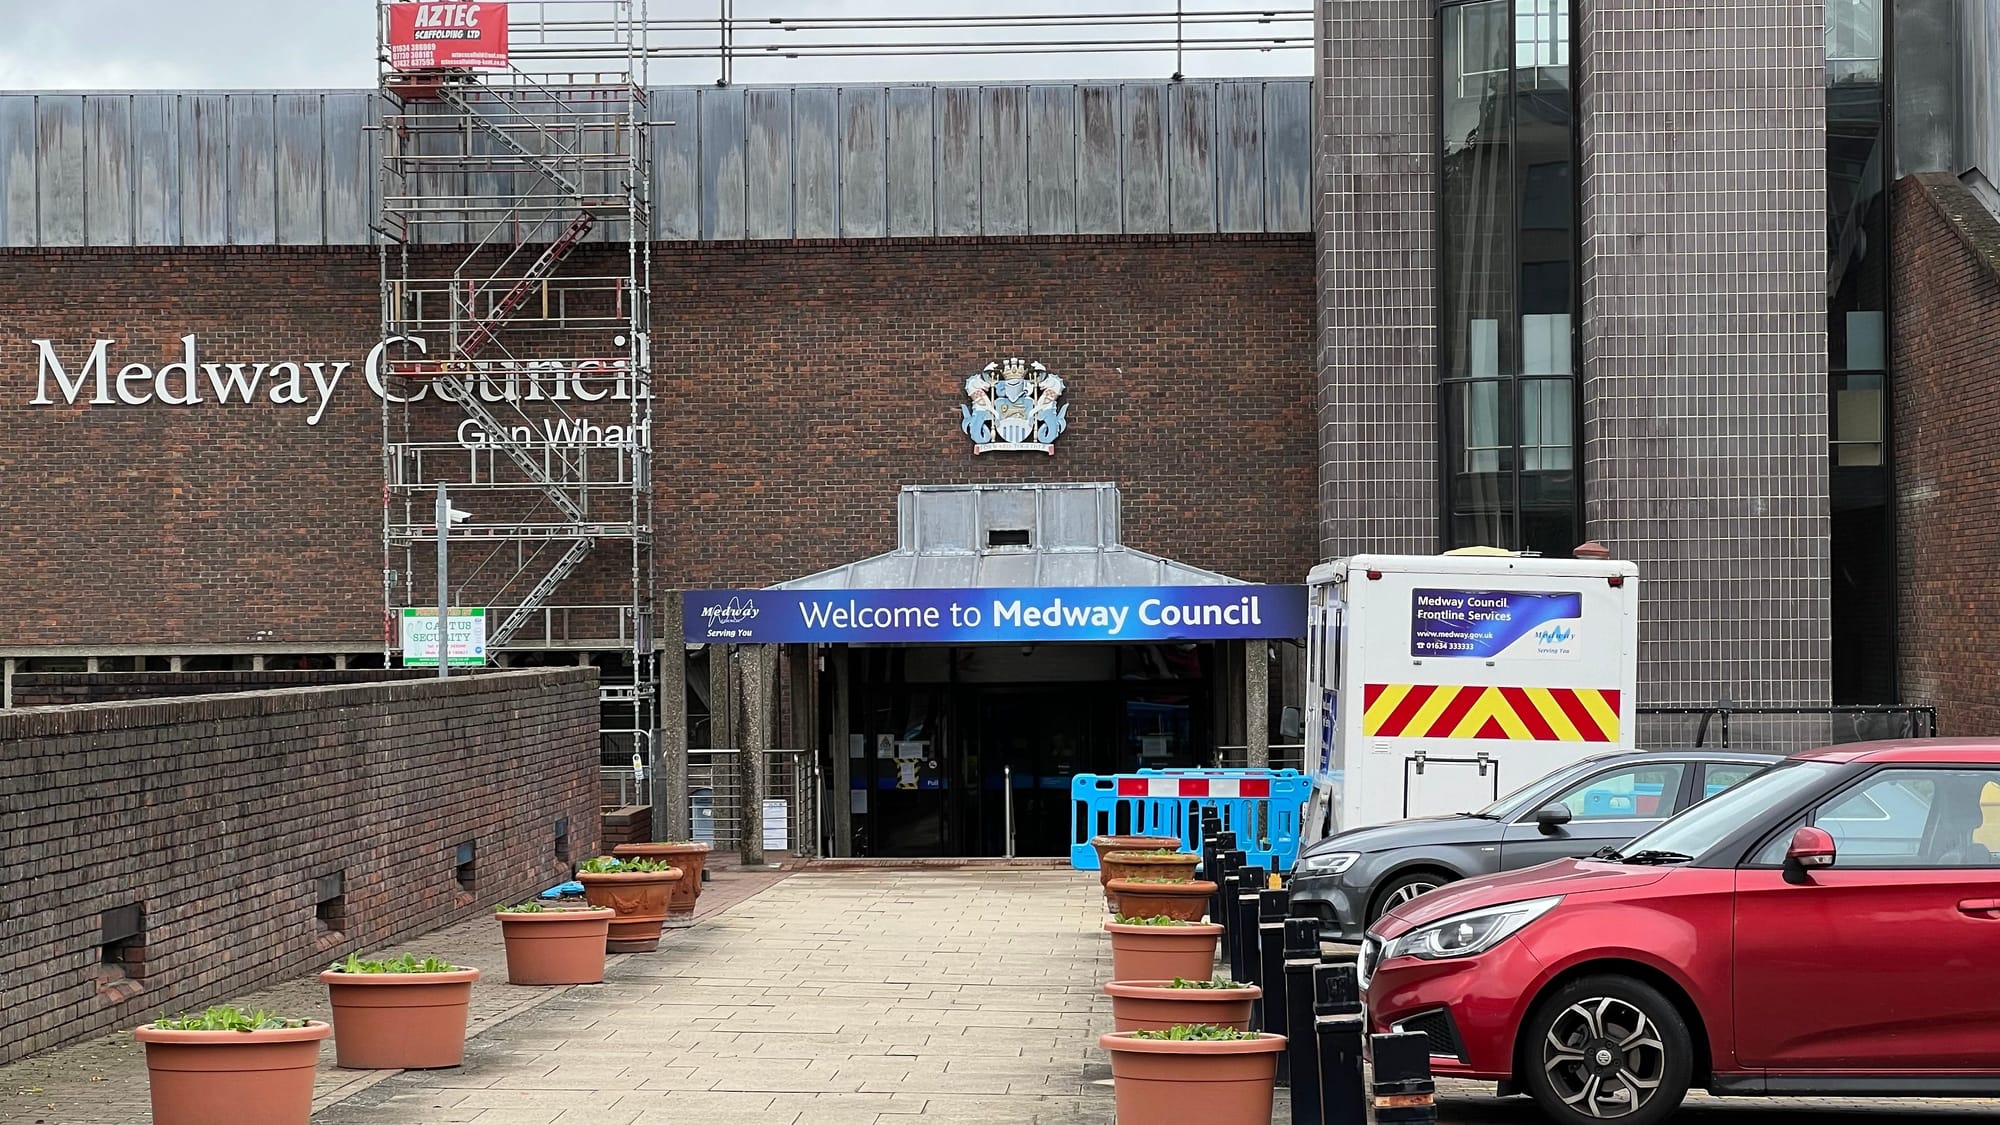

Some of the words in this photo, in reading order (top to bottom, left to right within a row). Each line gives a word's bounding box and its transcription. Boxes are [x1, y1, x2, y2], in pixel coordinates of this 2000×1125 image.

[415, 4, 481, 27] AZTEC
[415, 30, 464, 39] SCAFFOLDING
[467, 30, 481, 39] LTD
[29, 333, 351, 425] Medway
[364, 332, 656, 403] Council
[543, 417, 651, 449] Wharf
[1417, 596, 1464, 608] Medway
[1467, 597, 1507, 608] Council
[700, 606, 760, 619] Medway
[799, 600, 940, 628] Welcome
[950, 604, 981, 628] to
[992, 599, 1129, 634] Medway
[1138, 597, 1261, 627] Council
[1417, 609, 1465, 620] Frontline
[1468, 610, 1512, 621] Services
[425, 622, 471, 630] CATUS
[413, 633, 471, 641] SECUITY
[706, 629, 736, 638] Serving
[737, 628, 753, 637] You
[1416, 631, 1494, 640] www.medway.gov.uk
[1426, 642, 1447, 650] 01634
